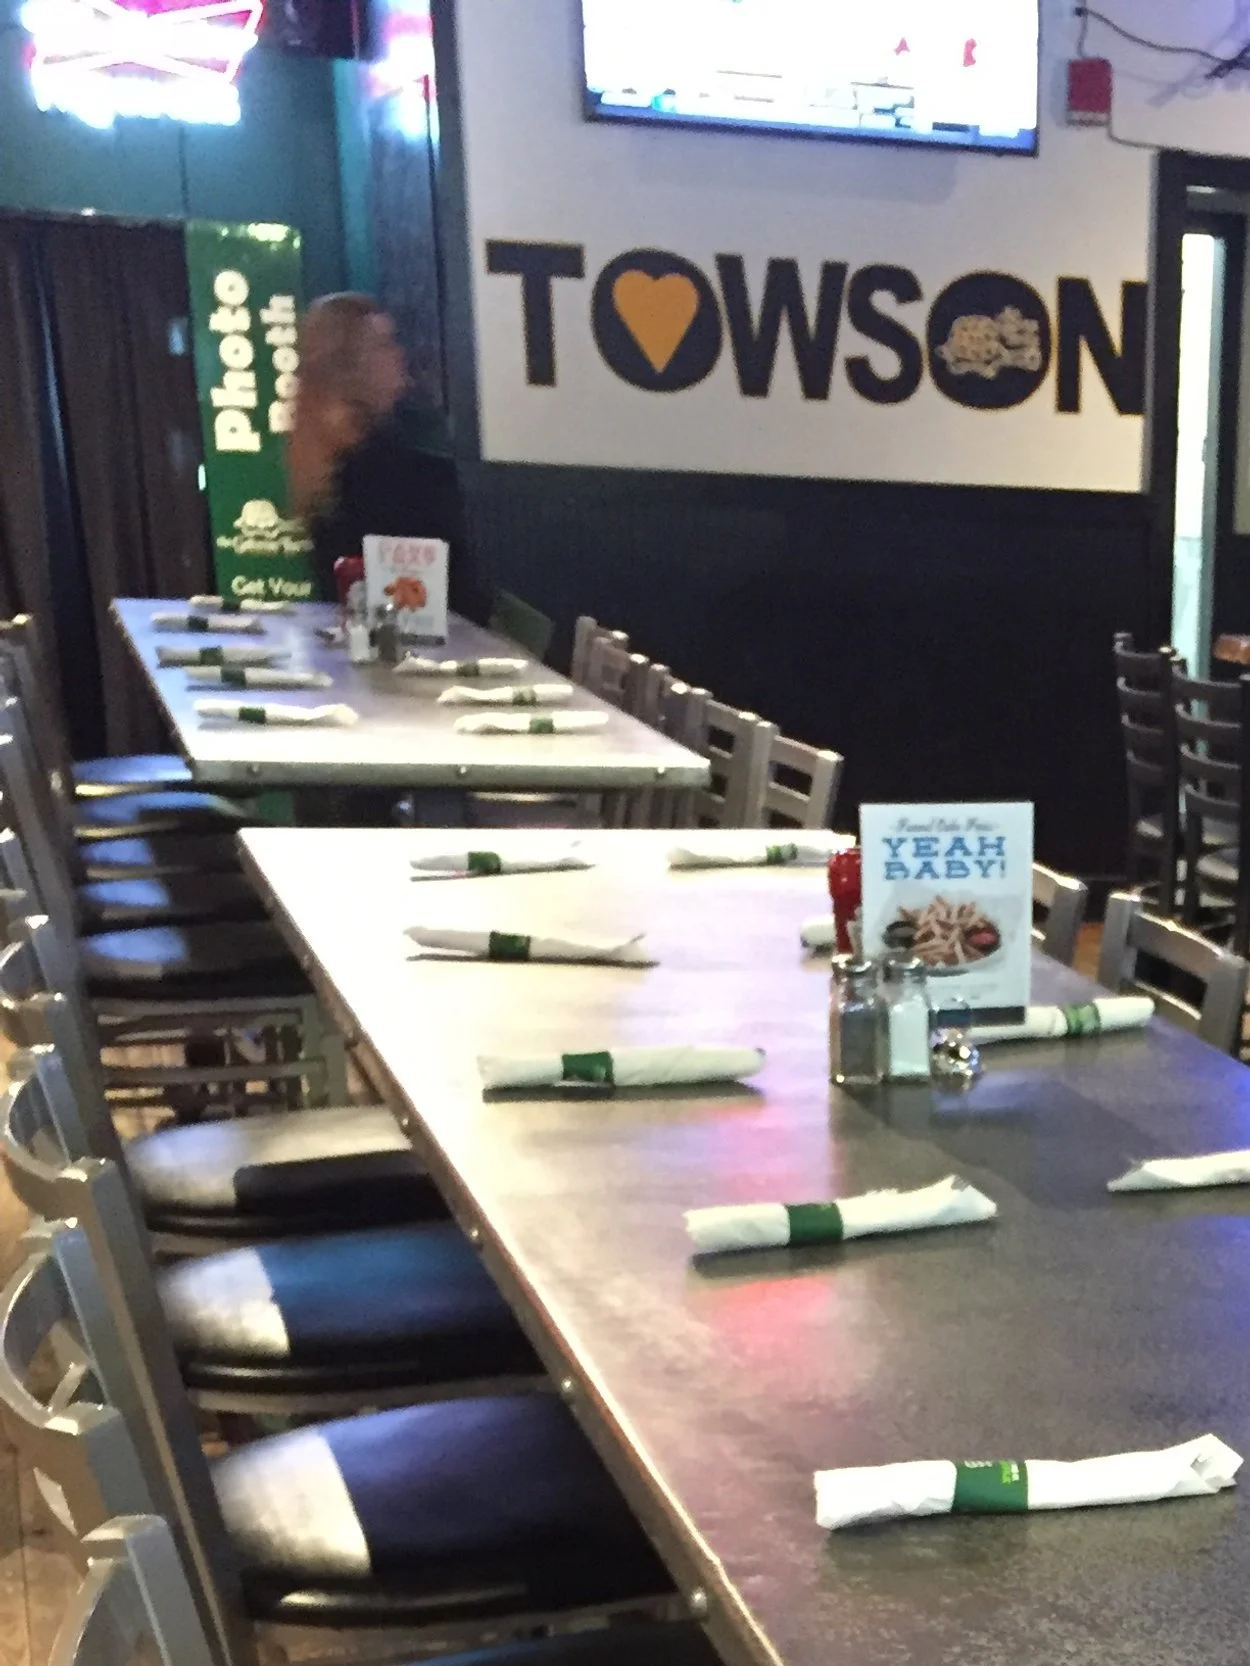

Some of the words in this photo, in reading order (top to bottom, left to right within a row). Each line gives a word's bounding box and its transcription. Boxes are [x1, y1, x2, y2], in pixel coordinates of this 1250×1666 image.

[484, 239, 1147, 416] TOWSON
[209, 268, 261, 452] Photo
[231, 575, 265, 596] Get
[882, 836, 1006, 857] YEAH
[884, 860, 1007, 880] BABY!
